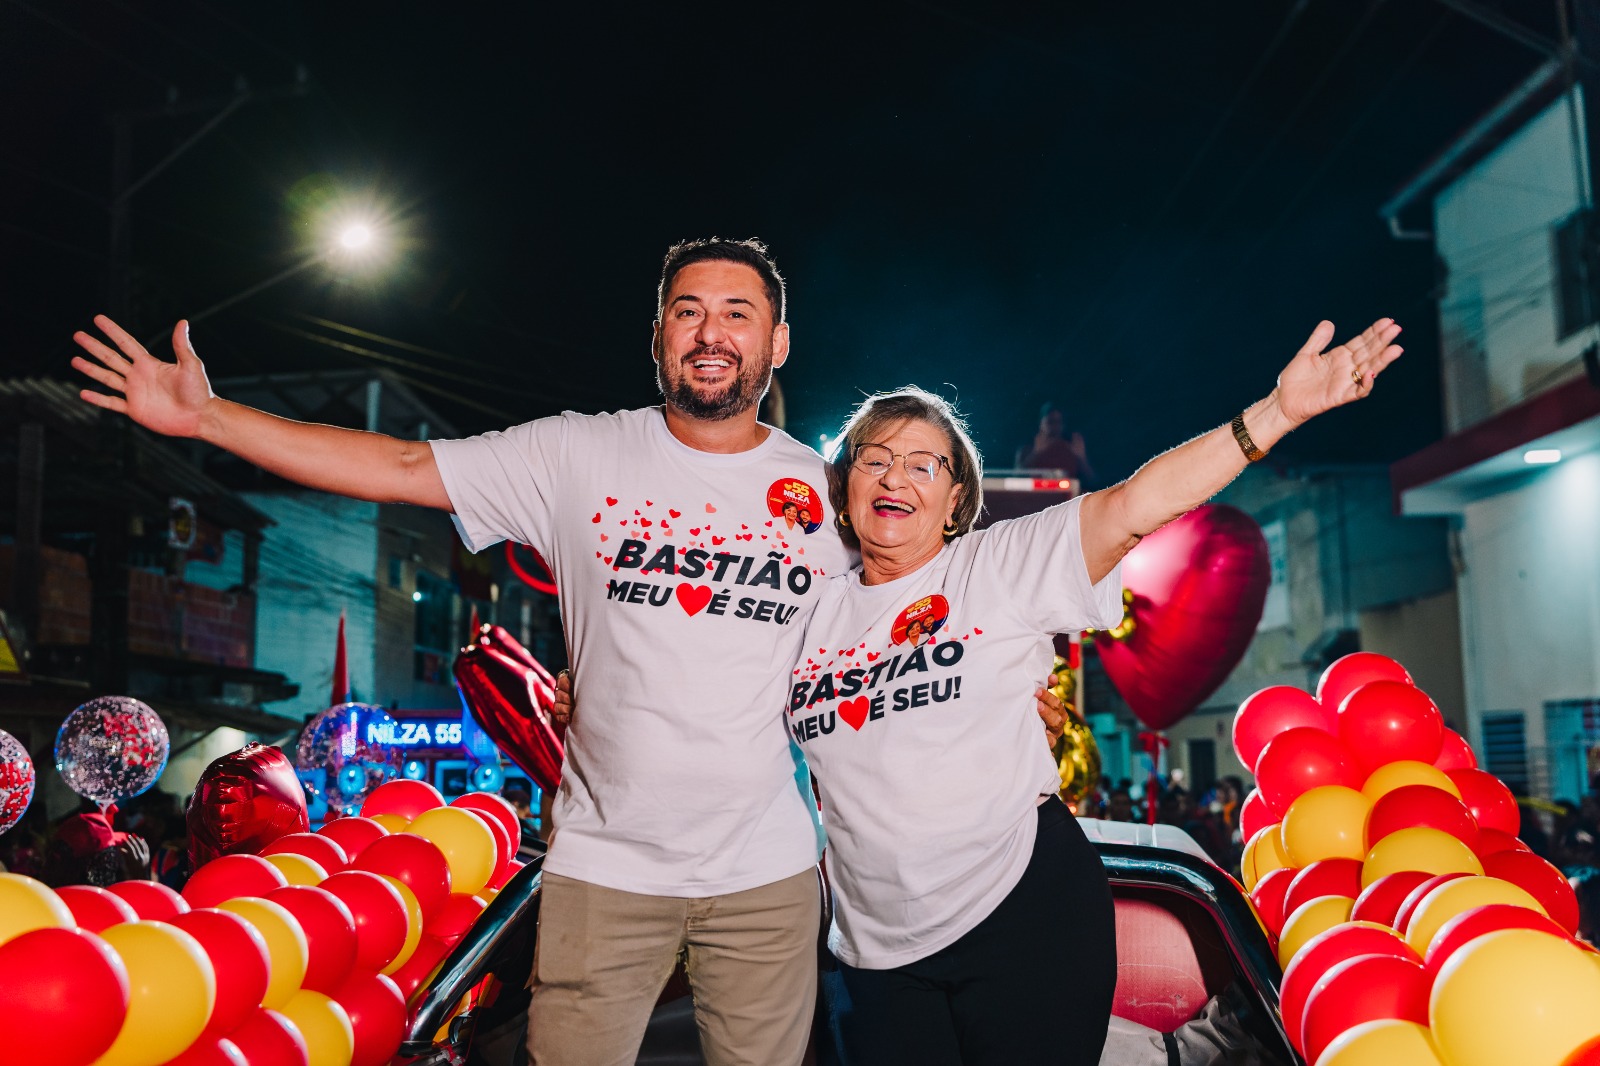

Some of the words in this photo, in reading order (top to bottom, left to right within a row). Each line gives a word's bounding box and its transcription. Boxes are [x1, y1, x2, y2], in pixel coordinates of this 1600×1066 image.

[783, 489, 811, 505] NILZA
[792, 482, 810, 497] 55
[613, 538, 812, 596] BASTIÃO
[606, 579, 673, 607] MEU
[706, 588, 731, 616] É
[733, 597, 799, 626] SEU!
[792, 710, 836, 745] MEU
[869, 690, 885, 722] É
[891, 675, 963, 713] SEU!
[367, 723, 431, 744] NILZA
[435, 723, 462, 744] 55
